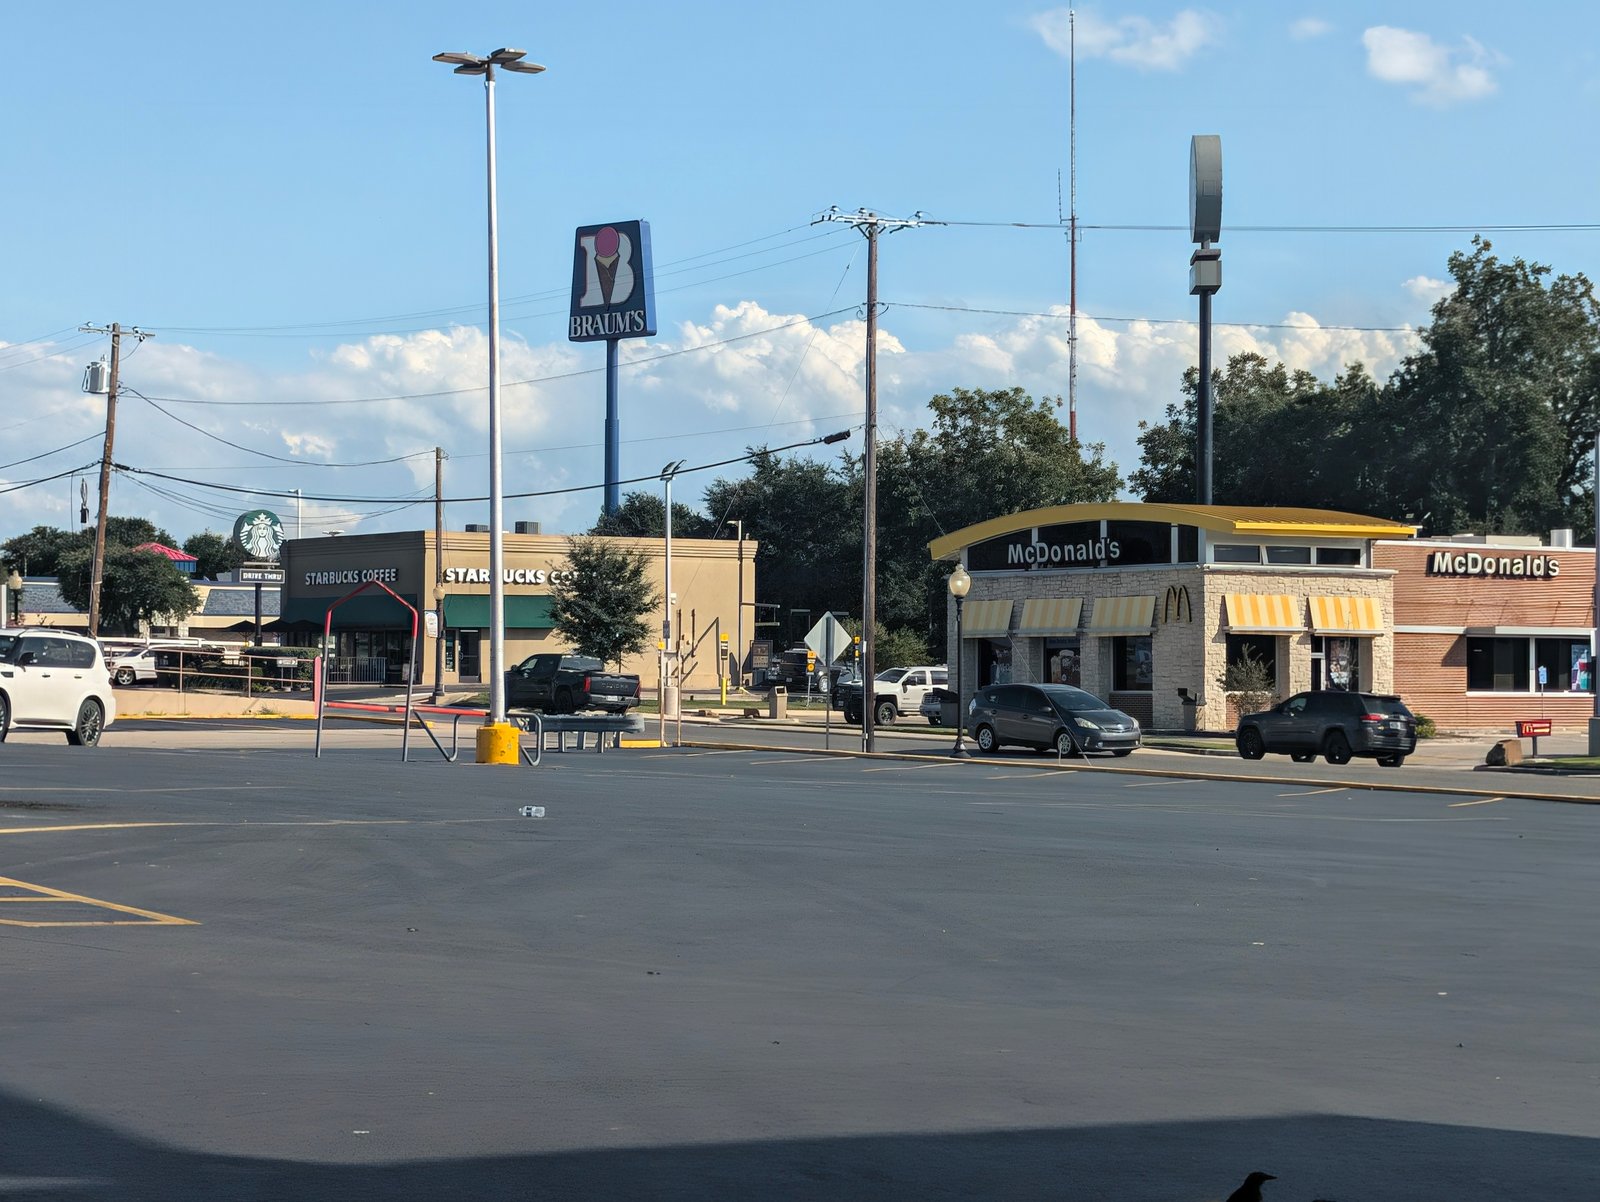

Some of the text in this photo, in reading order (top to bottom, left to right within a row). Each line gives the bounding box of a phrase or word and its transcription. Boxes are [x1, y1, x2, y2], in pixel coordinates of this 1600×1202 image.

[570, 310, 645, 337] BRAUM'S
[1008, 539, 1120, 564] McDonald's
[242, 572, 282, 581] DRIVE THRU
[305, 568, 397, 585] STARBUCKS COFFEE
[445, 568, 546, 584] STARUCKS
